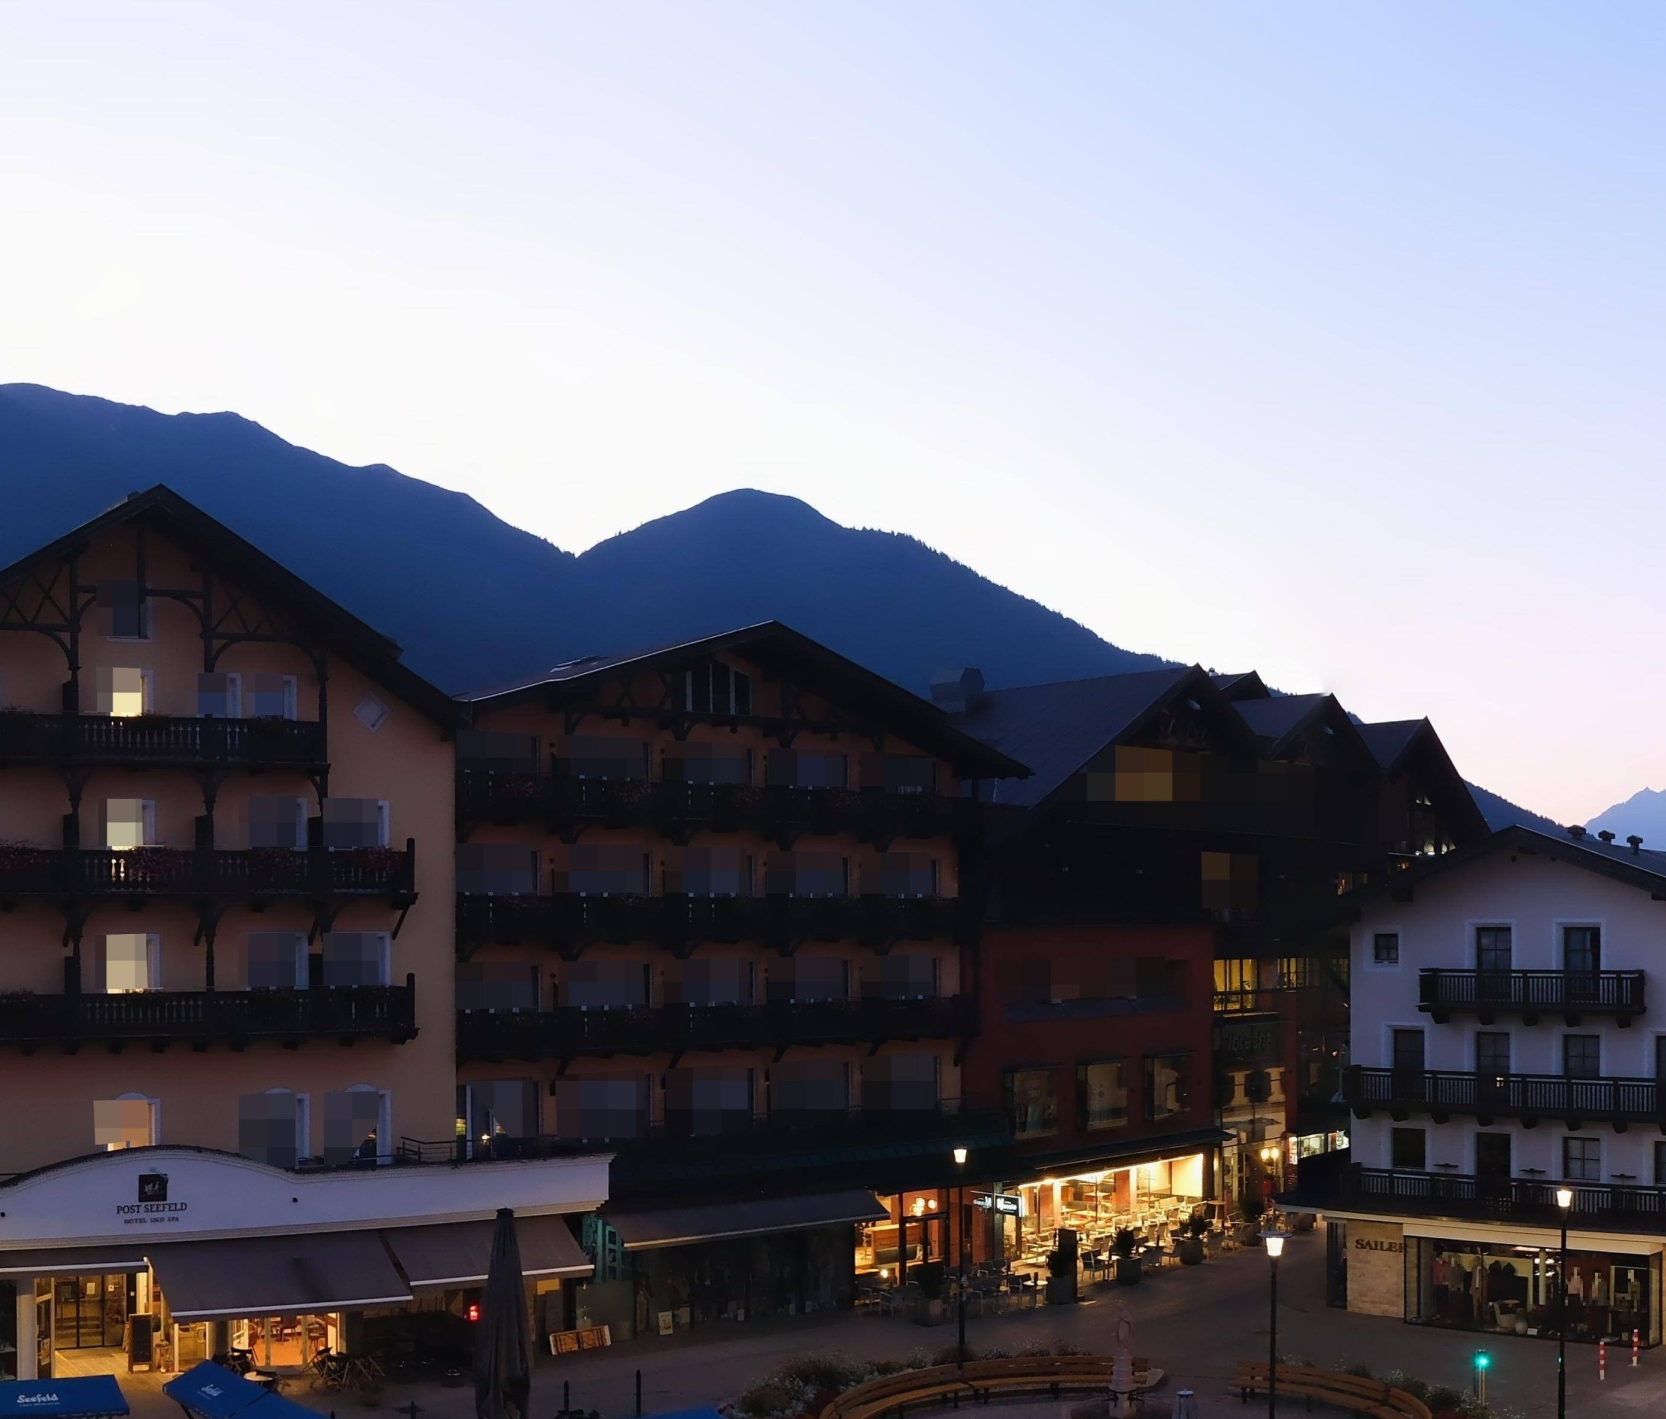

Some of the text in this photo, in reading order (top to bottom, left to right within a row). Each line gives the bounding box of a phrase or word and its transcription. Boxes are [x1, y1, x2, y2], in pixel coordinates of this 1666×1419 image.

[117, 1202, 187, 1214] POST SEEFELD
[17, 1393, 60, 1405] Seefeld
